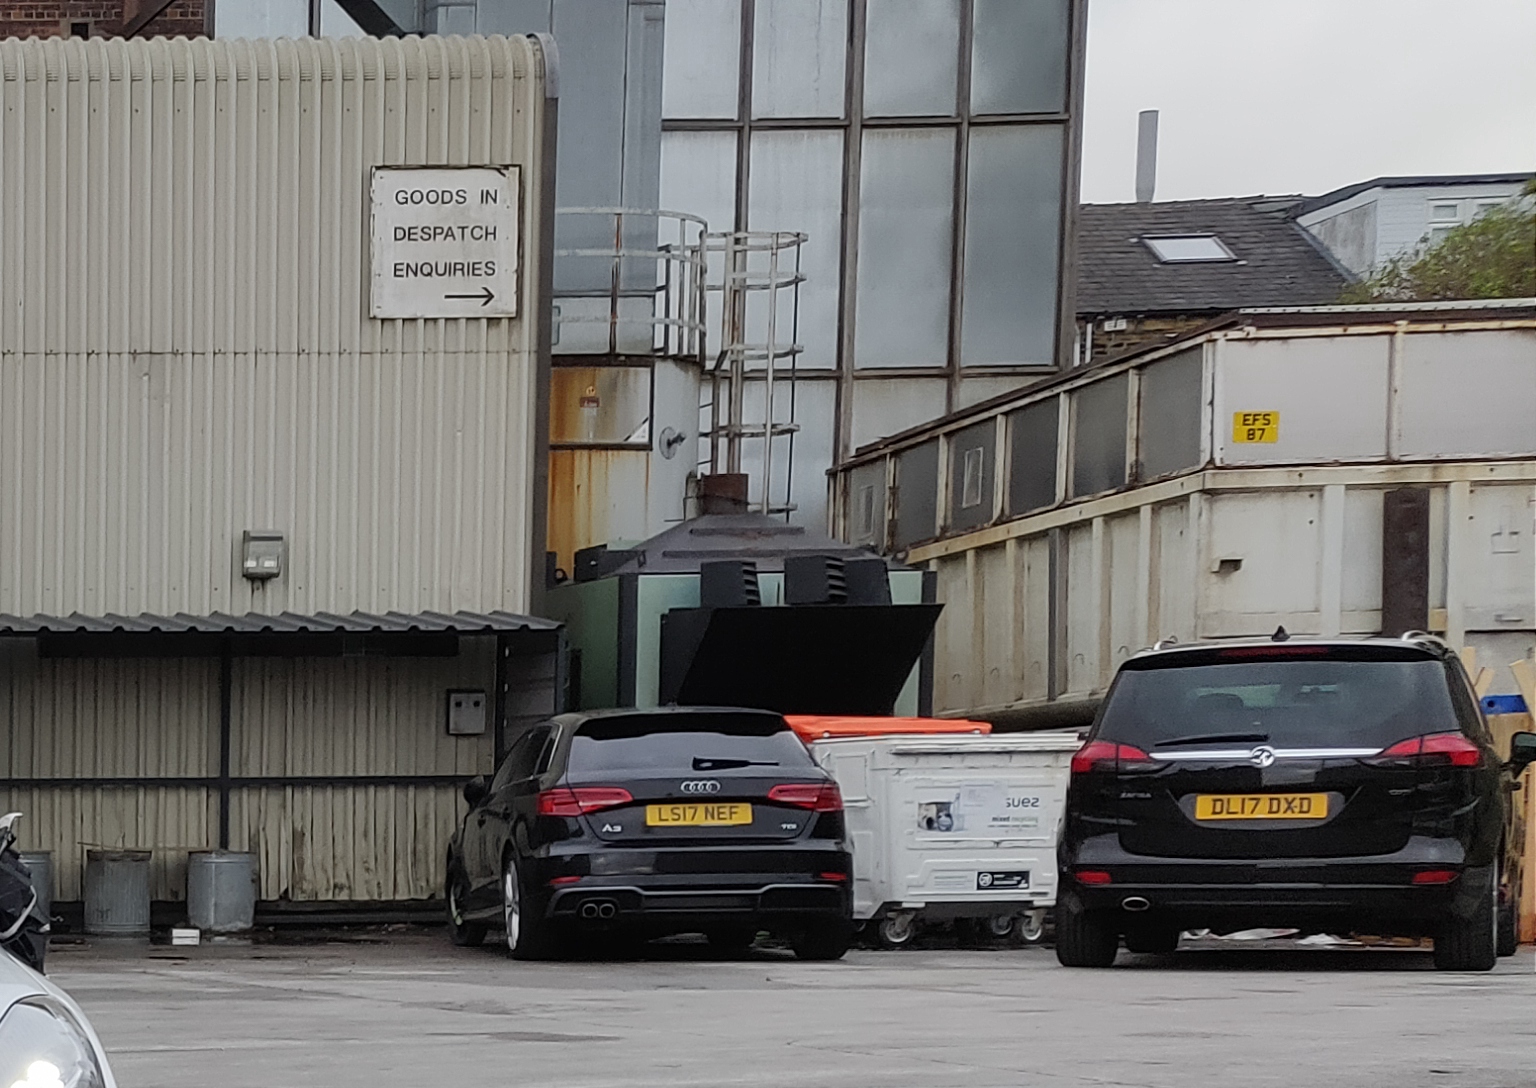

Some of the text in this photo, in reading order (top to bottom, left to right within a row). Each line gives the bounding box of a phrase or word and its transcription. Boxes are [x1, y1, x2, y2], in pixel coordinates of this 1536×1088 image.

[395, 188, 498, 205] GOODS IN
[393, 226, 497, 241] DESPATCH
[393, 261, 496, 278] ENQUIRIES
[1242, 413, 1271, 426] EFS
[1247, 428, 1266, 441] 87
[659, 805, 740, 821] LS17 NEF
[1211, 796, 1312, 815] DL17 DXD
[602, 824, 622, 832] A3
